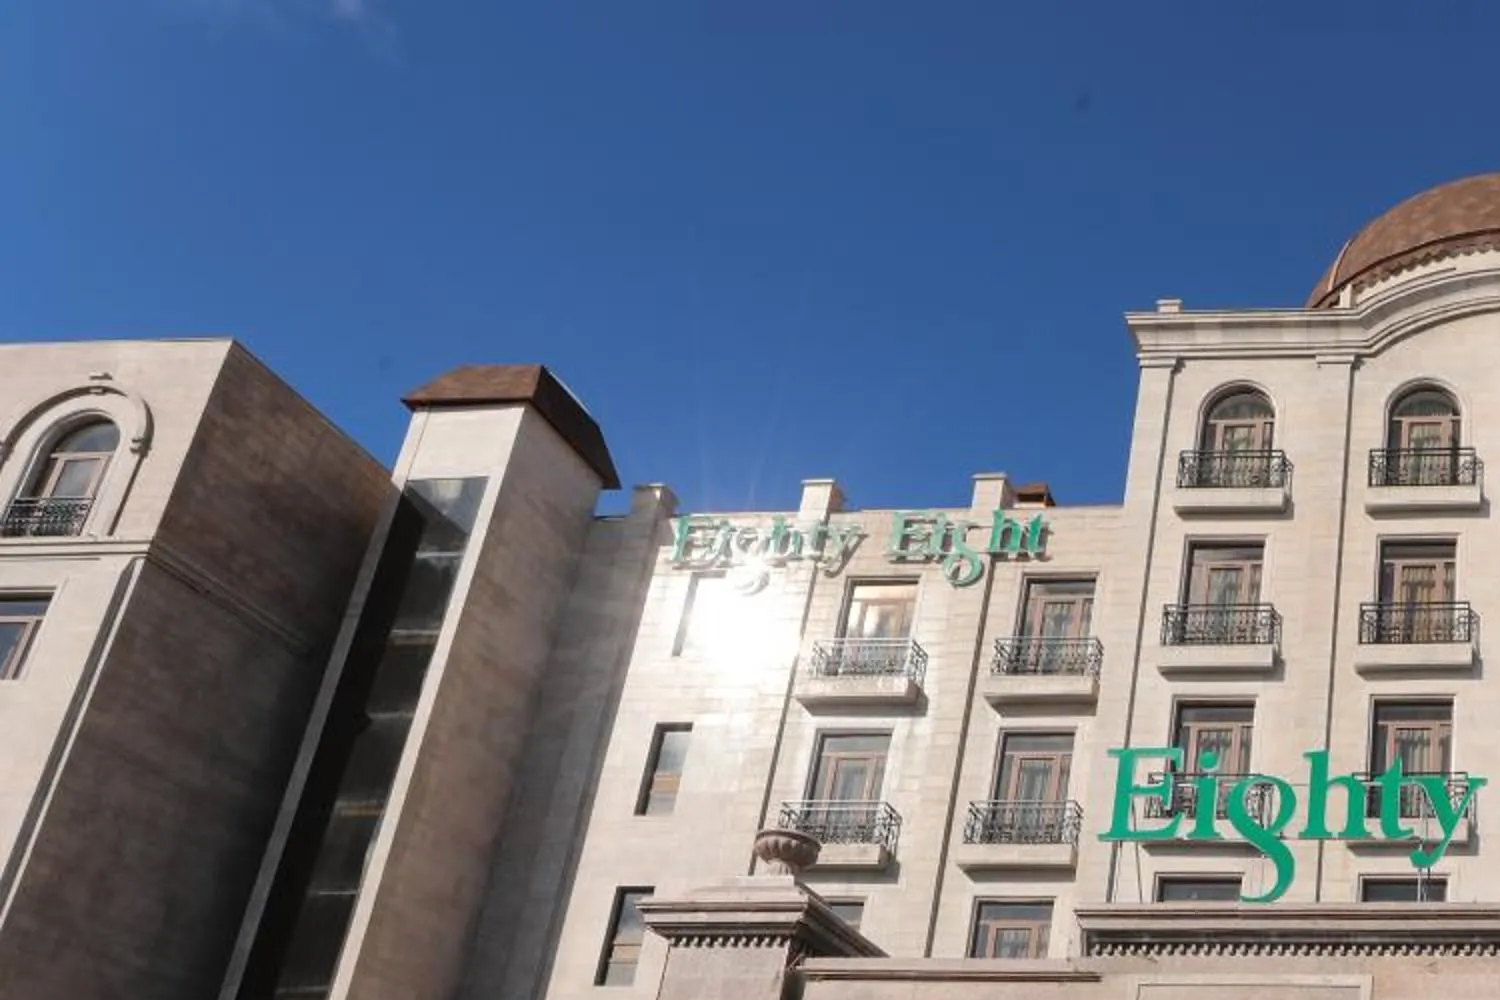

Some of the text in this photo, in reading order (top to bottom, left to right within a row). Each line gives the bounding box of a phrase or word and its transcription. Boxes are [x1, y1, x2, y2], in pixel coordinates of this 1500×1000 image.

[670, 508, 1052, 595] Eighty Eight
[1097, 746, 1488, 904] Eighty
